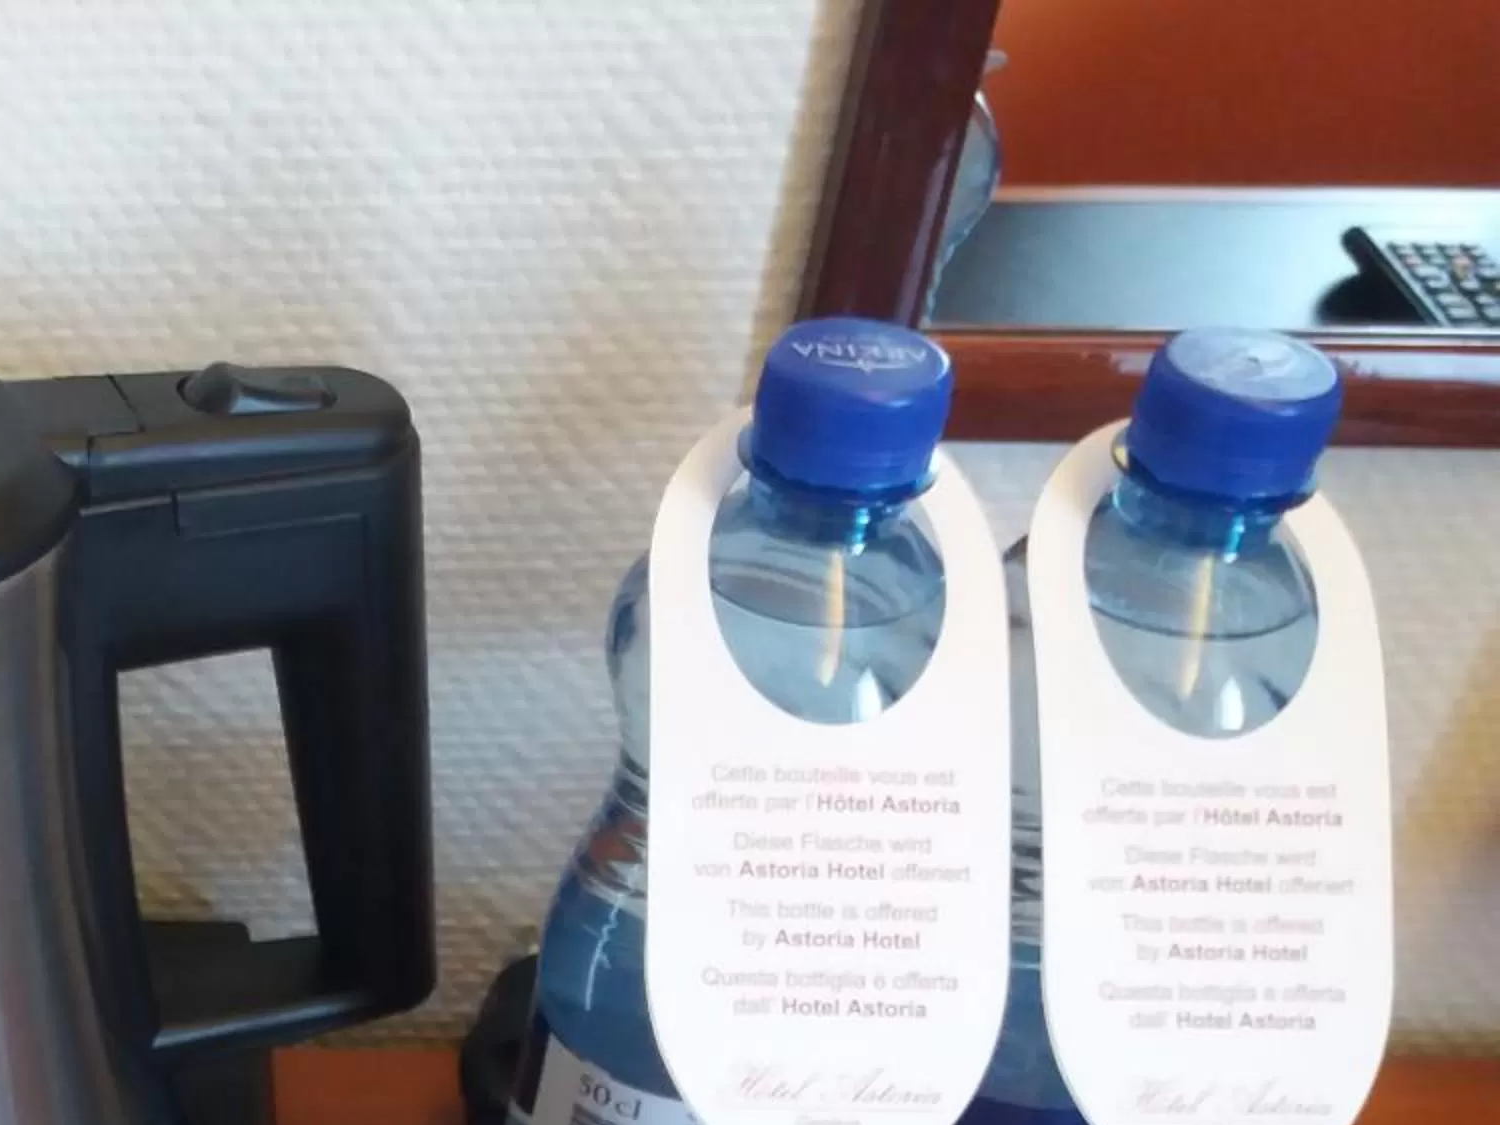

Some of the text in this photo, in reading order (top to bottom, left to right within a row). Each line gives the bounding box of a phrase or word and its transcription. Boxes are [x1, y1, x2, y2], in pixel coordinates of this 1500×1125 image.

[880, 794, 961, 814] Astoria
[1266, 807, 1344, 828] Astoria
[693, 863, 732, 877] von
[739, 860, 820, 880] Astoria
[827, 861, 886, 880] Hotel
[1131, 874, 1209, 893] Astoria
[1215, 875, 1273, 894] Hotel
[741, 928, 922, 949] by Astoria Hotel
[1167, 942, 1247, 961] Astoria
[1252, 944, 1309, 962] Hotel
[780, 998, 841, 1017] Hotel
[846, 999, 928, 1018] Astoria
[1175, 1011, 1233, 1029] Hotel
[1238, 1011, 1317, 1030] Astoria
